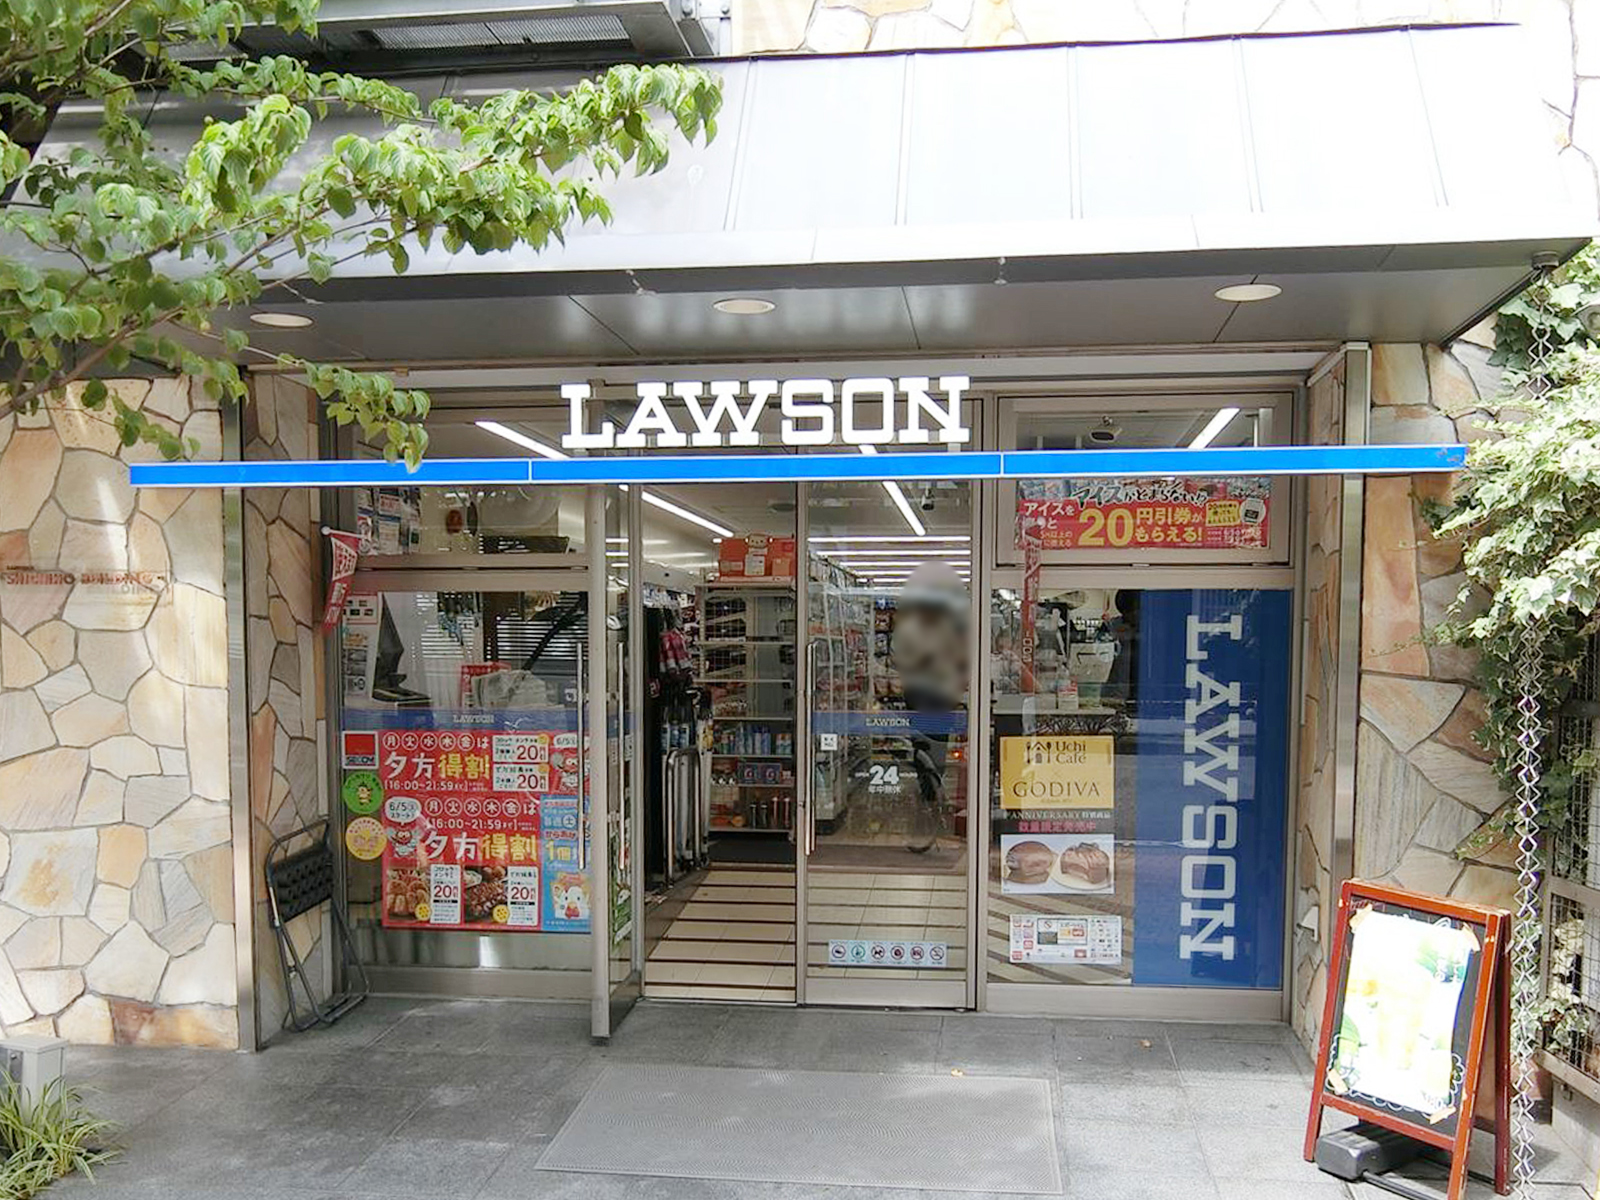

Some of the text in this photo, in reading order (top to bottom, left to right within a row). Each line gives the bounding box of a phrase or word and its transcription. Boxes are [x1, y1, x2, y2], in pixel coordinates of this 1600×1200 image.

[560, 376, 970, 448] LAWSON
[1024, 502, 1075, 516] アイスを
[1077, 507, 1134, 547] 20
[1135, 527, 1202, 542] もらえる!
[865, 717, 911, 727] LAWSON
[516, 744, 539, 761] 20
[1055, 740, 1087, 752] Uchi
[383, 751, 490, 780] 夕方得割
[1055, 752, 1087, 764] Café
[516, 774, 539, 790] 20
[869, 764, 900, 786] 24
[1012, 780, 1100, 798] GODIVA
[1179, 615, 1243, 961] LAWSON
[424, 831, 538, 861] 夕方得割
[433, 885, 453, 899] 20
[510, 886, 530, 901] 20
